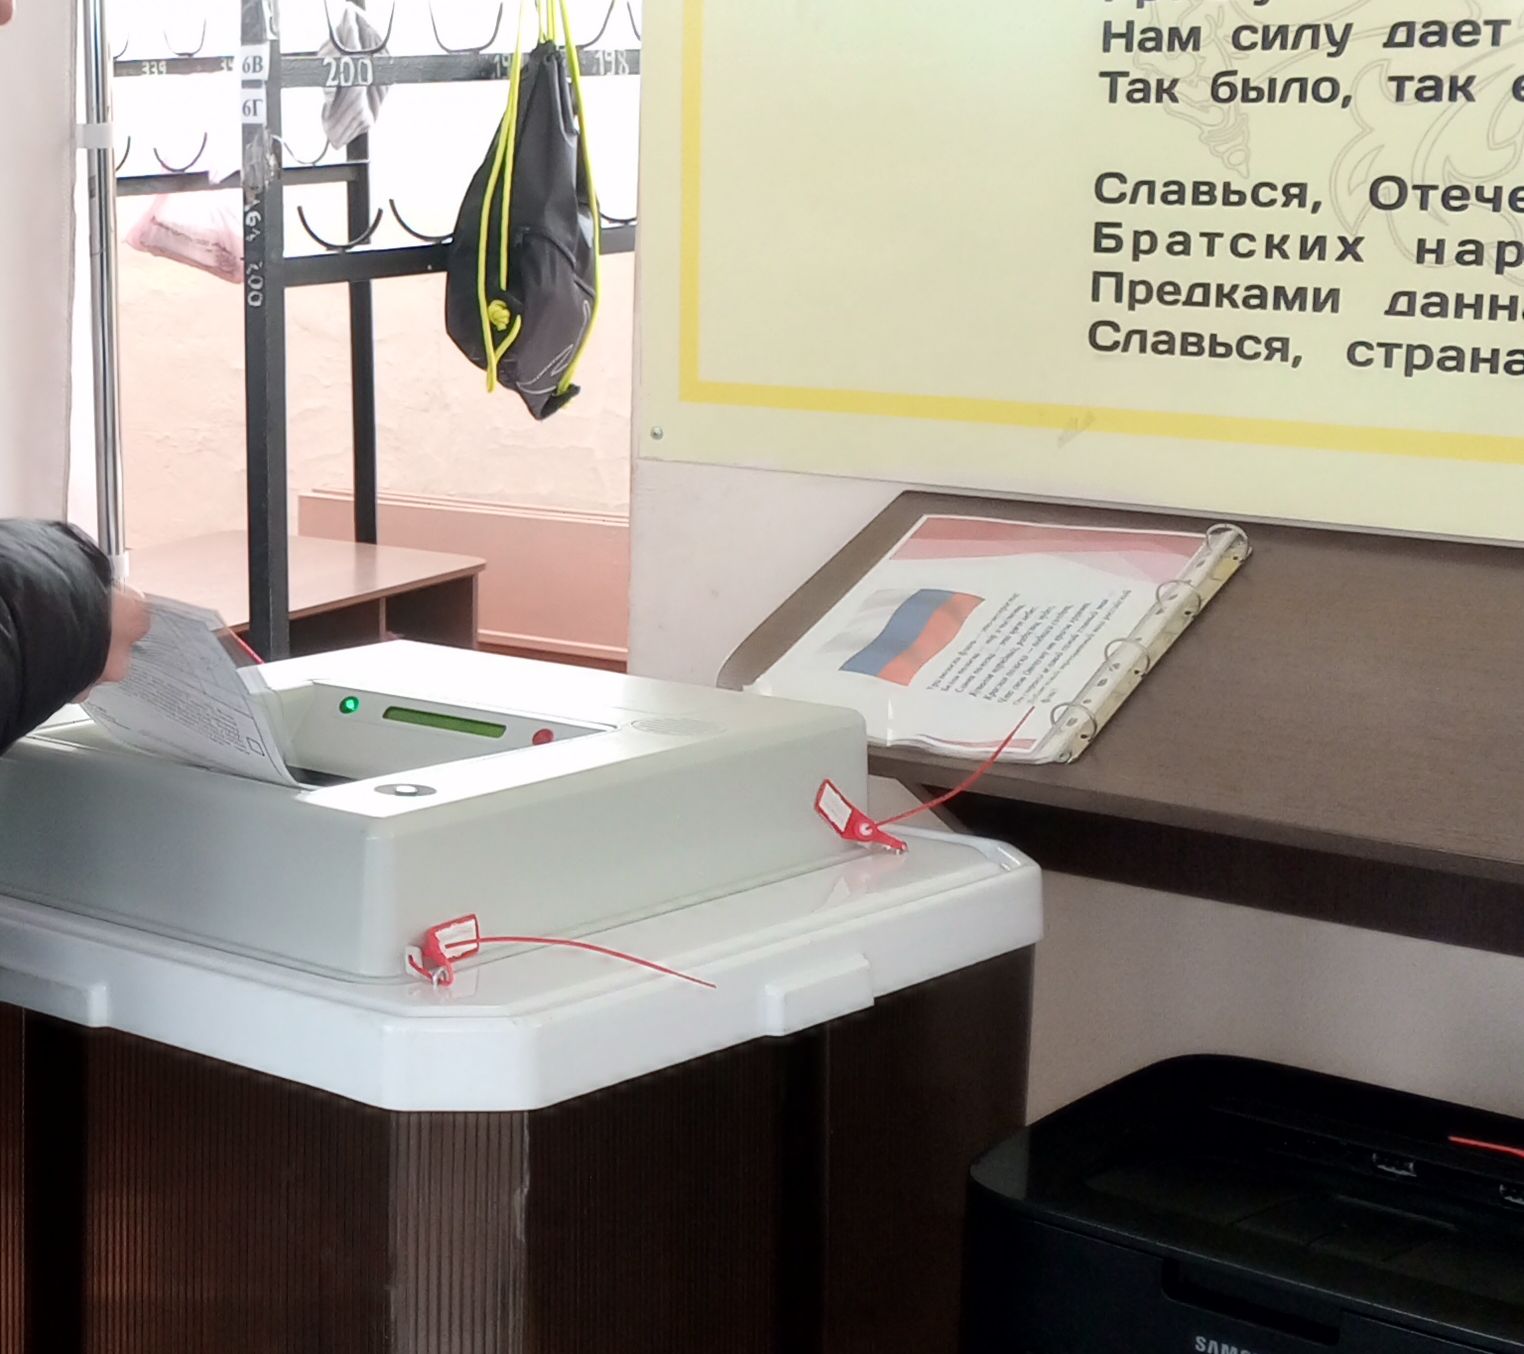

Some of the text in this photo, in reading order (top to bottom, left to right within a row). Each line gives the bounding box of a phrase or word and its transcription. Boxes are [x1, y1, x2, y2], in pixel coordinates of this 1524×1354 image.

[1102, 19, 1511, 58] Нам силу дает
[241, 55, 264, 76] 6В
[323, 55, 374, 86] 200
[594, 49, 631, 75] 198
[241, 98, 263, 118] 6Г
[1098, 71, 1181, 104] Так
[1210, 70, 1352, 109] было,
[1387, 75, 1476, 103] так
[1094, 172, 1322, 214] Славься,
[1093, 221, 1365, 262] Братских
[1091, 271, 1340, 313] Предками
[1088, 320, 1302, 368] Славься,
